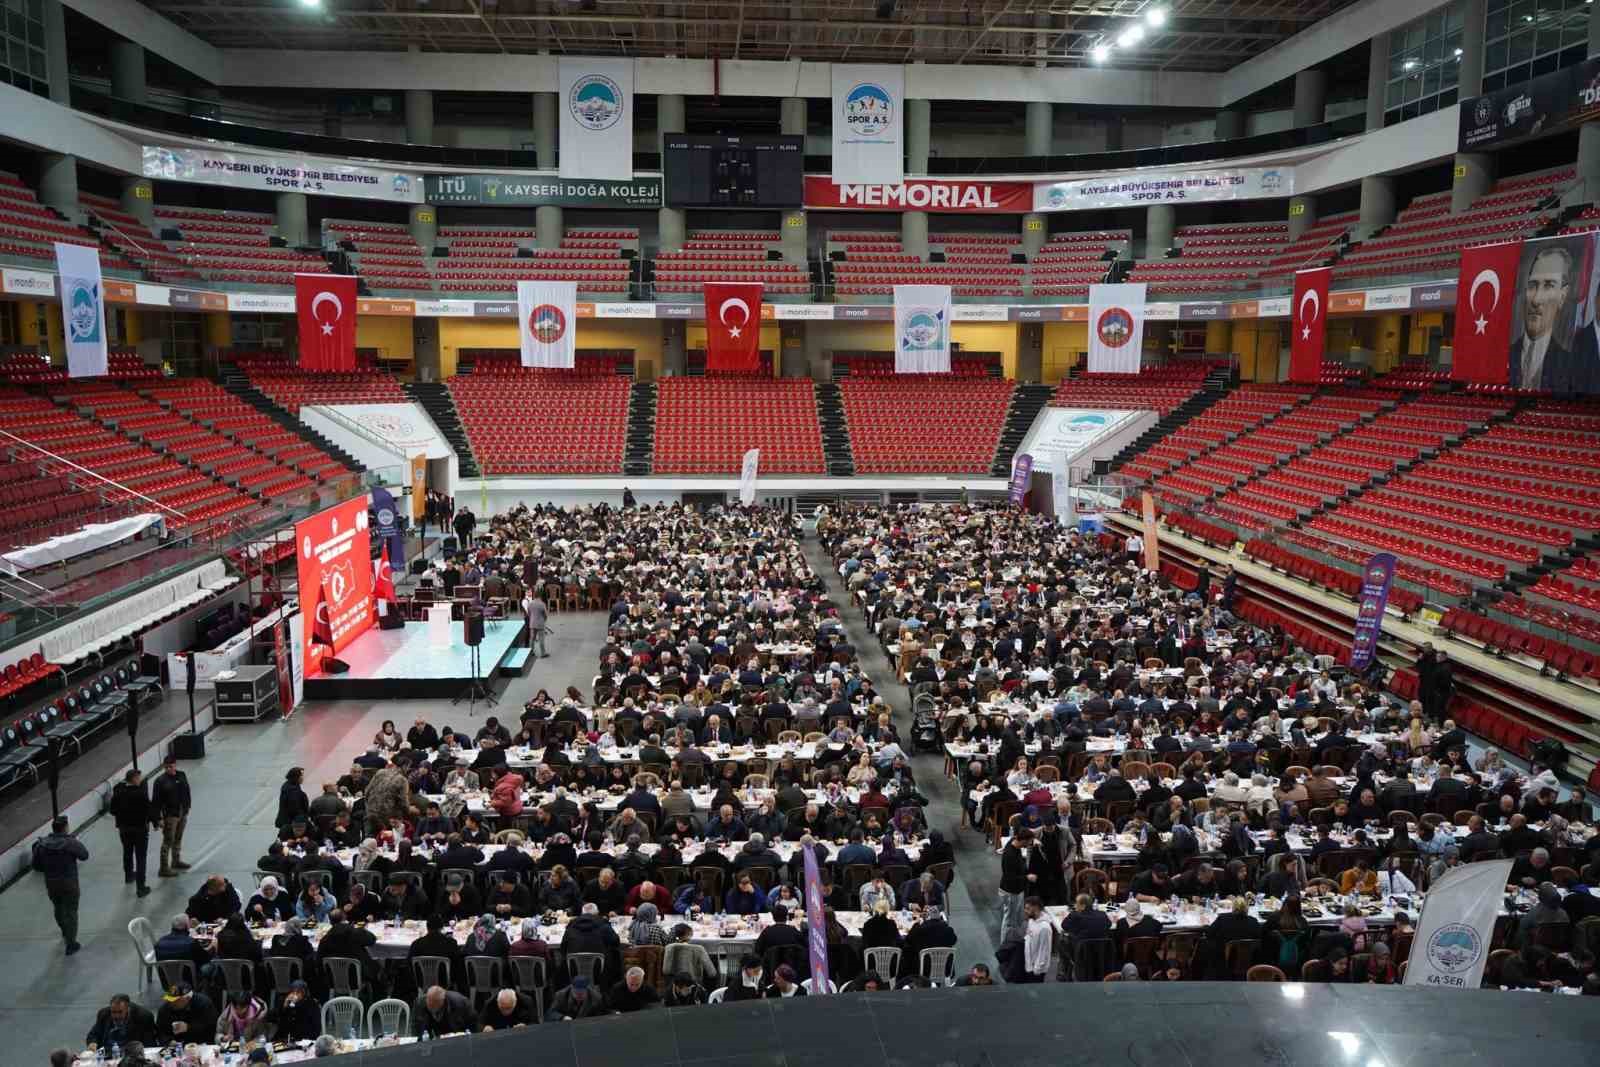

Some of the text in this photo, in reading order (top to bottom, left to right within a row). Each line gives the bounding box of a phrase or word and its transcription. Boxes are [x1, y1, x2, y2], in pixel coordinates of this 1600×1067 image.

[847, 115, 870, 124] SPOR
[203, 160, 251, 173] KAYSERİ
[322, 172, 379, 185] BELEDİYESİ
[265, 177, 299, 188] SPOR
[438, 176, 466, 194] İTÜ
[504, 184, 659, 198] KAYSERİ DOĞA KOLEJİ
[839, 184, 999, 208] MEMORIAL
[1080, 186, 1120, 196] KAYSERİ
[1131, 192, 1161, 201] SPOR
